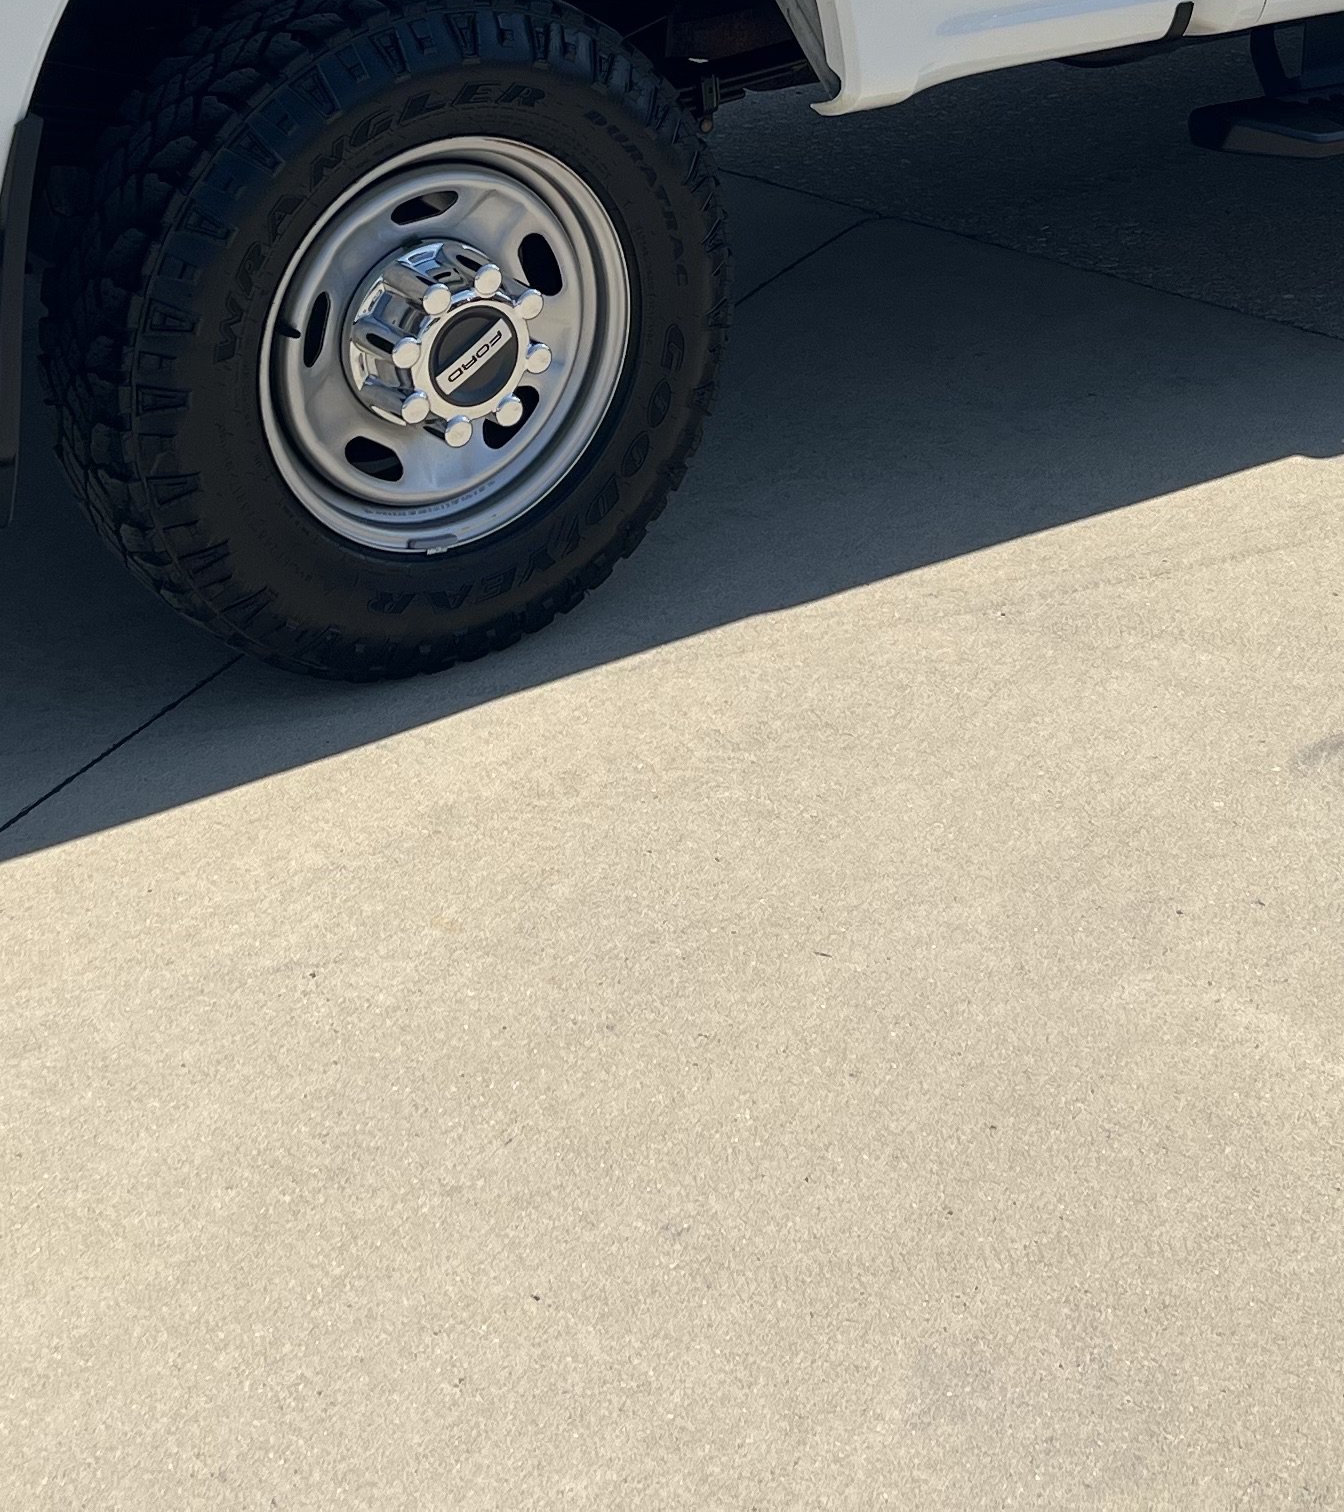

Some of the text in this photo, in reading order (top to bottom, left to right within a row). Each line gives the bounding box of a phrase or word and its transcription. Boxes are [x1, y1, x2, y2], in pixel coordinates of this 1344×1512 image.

[213, 81, 549, 364] WRANGLER
[447, 330, 503, 383] FORD
[365, 324, 685, 616] GOODYEAR
